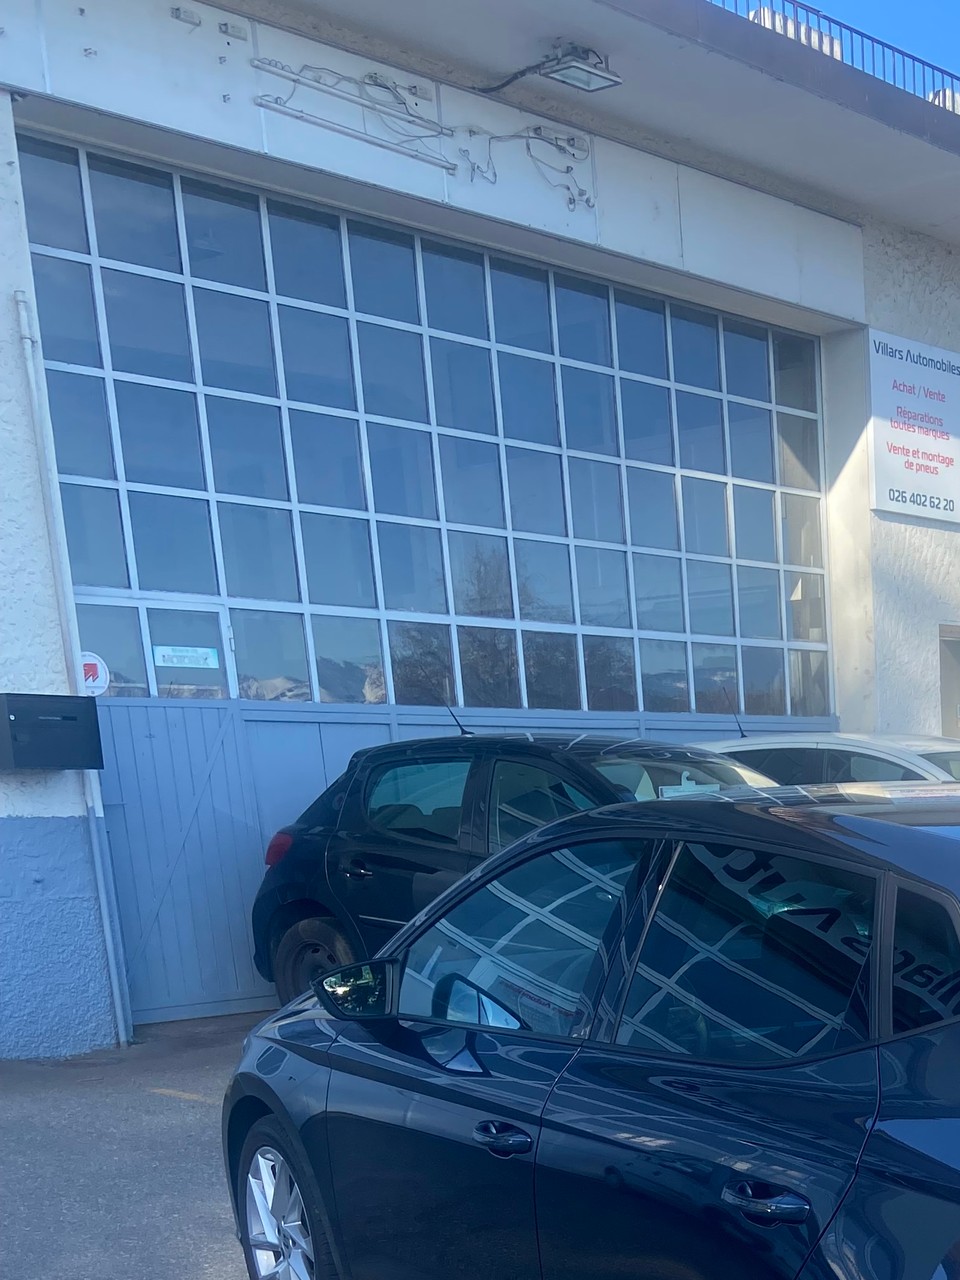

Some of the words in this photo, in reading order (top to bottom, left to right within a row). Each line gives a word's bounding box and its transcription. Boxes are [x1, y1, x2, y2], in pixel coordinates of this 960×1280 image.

[873, 339, 904, 361] Villars
[905, 349, 960, 376] Automobiles
[892, 379, 916, 396] Achat
[923, 387, 946, 403] Vente
[896, 406, 943, 427] Réparations
[890, 417, 916, 433] toutes
[917, 424, 950, 441] marques
[886, 441, 911, 457] Vente
[912, 447, 920, 459] et
[921, 449, 954, 466] montage
[904, 459, 914, 471] de
[915, 462, 939, 475] pneus
[888, 488, 906, 504] 026
[909, 492, 927, 507] 402
[929, 496, 941, 510] 62
[943, 498, 955, 512] 20
